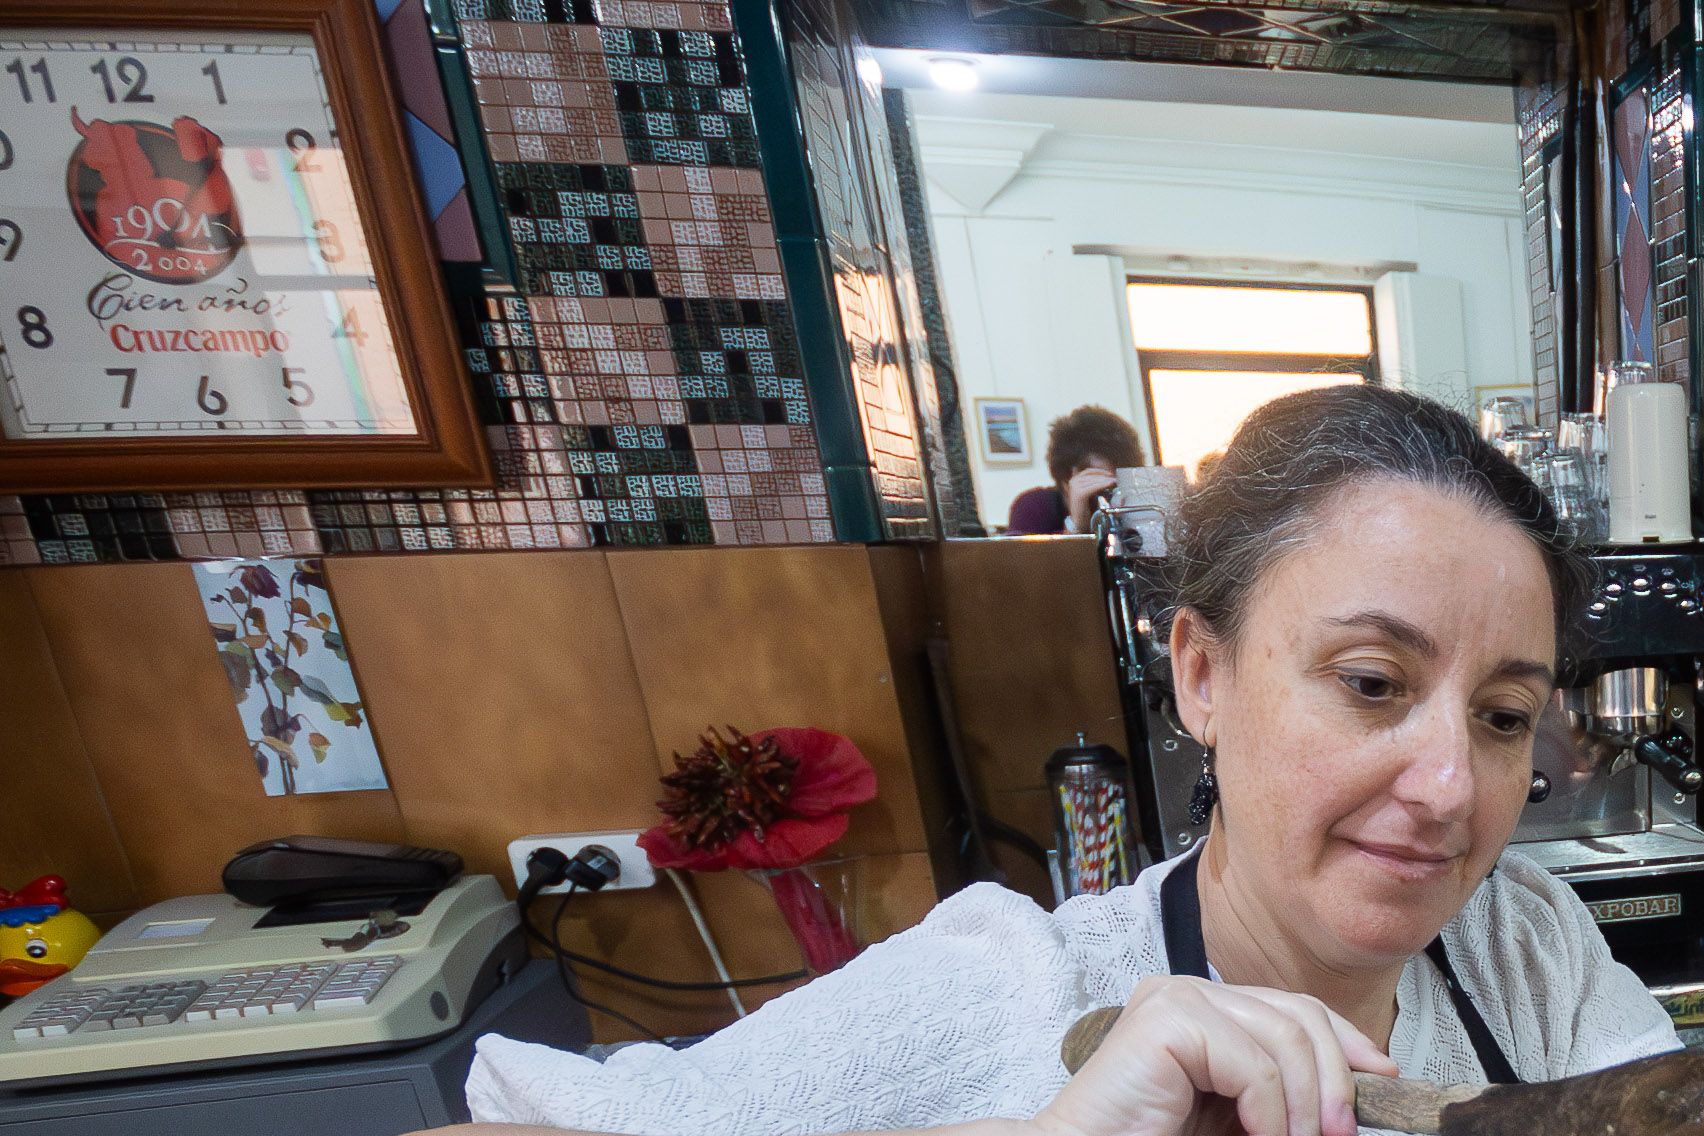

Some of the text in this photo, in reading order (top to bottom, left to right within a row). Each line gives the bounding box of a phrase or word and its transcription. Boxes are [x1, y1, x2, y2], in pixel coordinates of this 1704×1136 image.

[6, 56, 228, 105] 11 12 1
[285, 128, 323, 174] 2
[132, 248, 209, 276] 2004
[314, 219, 346, 263] 3
[87, 272, 189, 332] Cien
[18, 305, 54, 349] 8
[109, 323, 290, 358] Cruzcampo
[331, 306, 369, 348] 4
[104, 367, 315, 416] 7 6 5
[1593, 896, 1679, 919] XPOBAR
